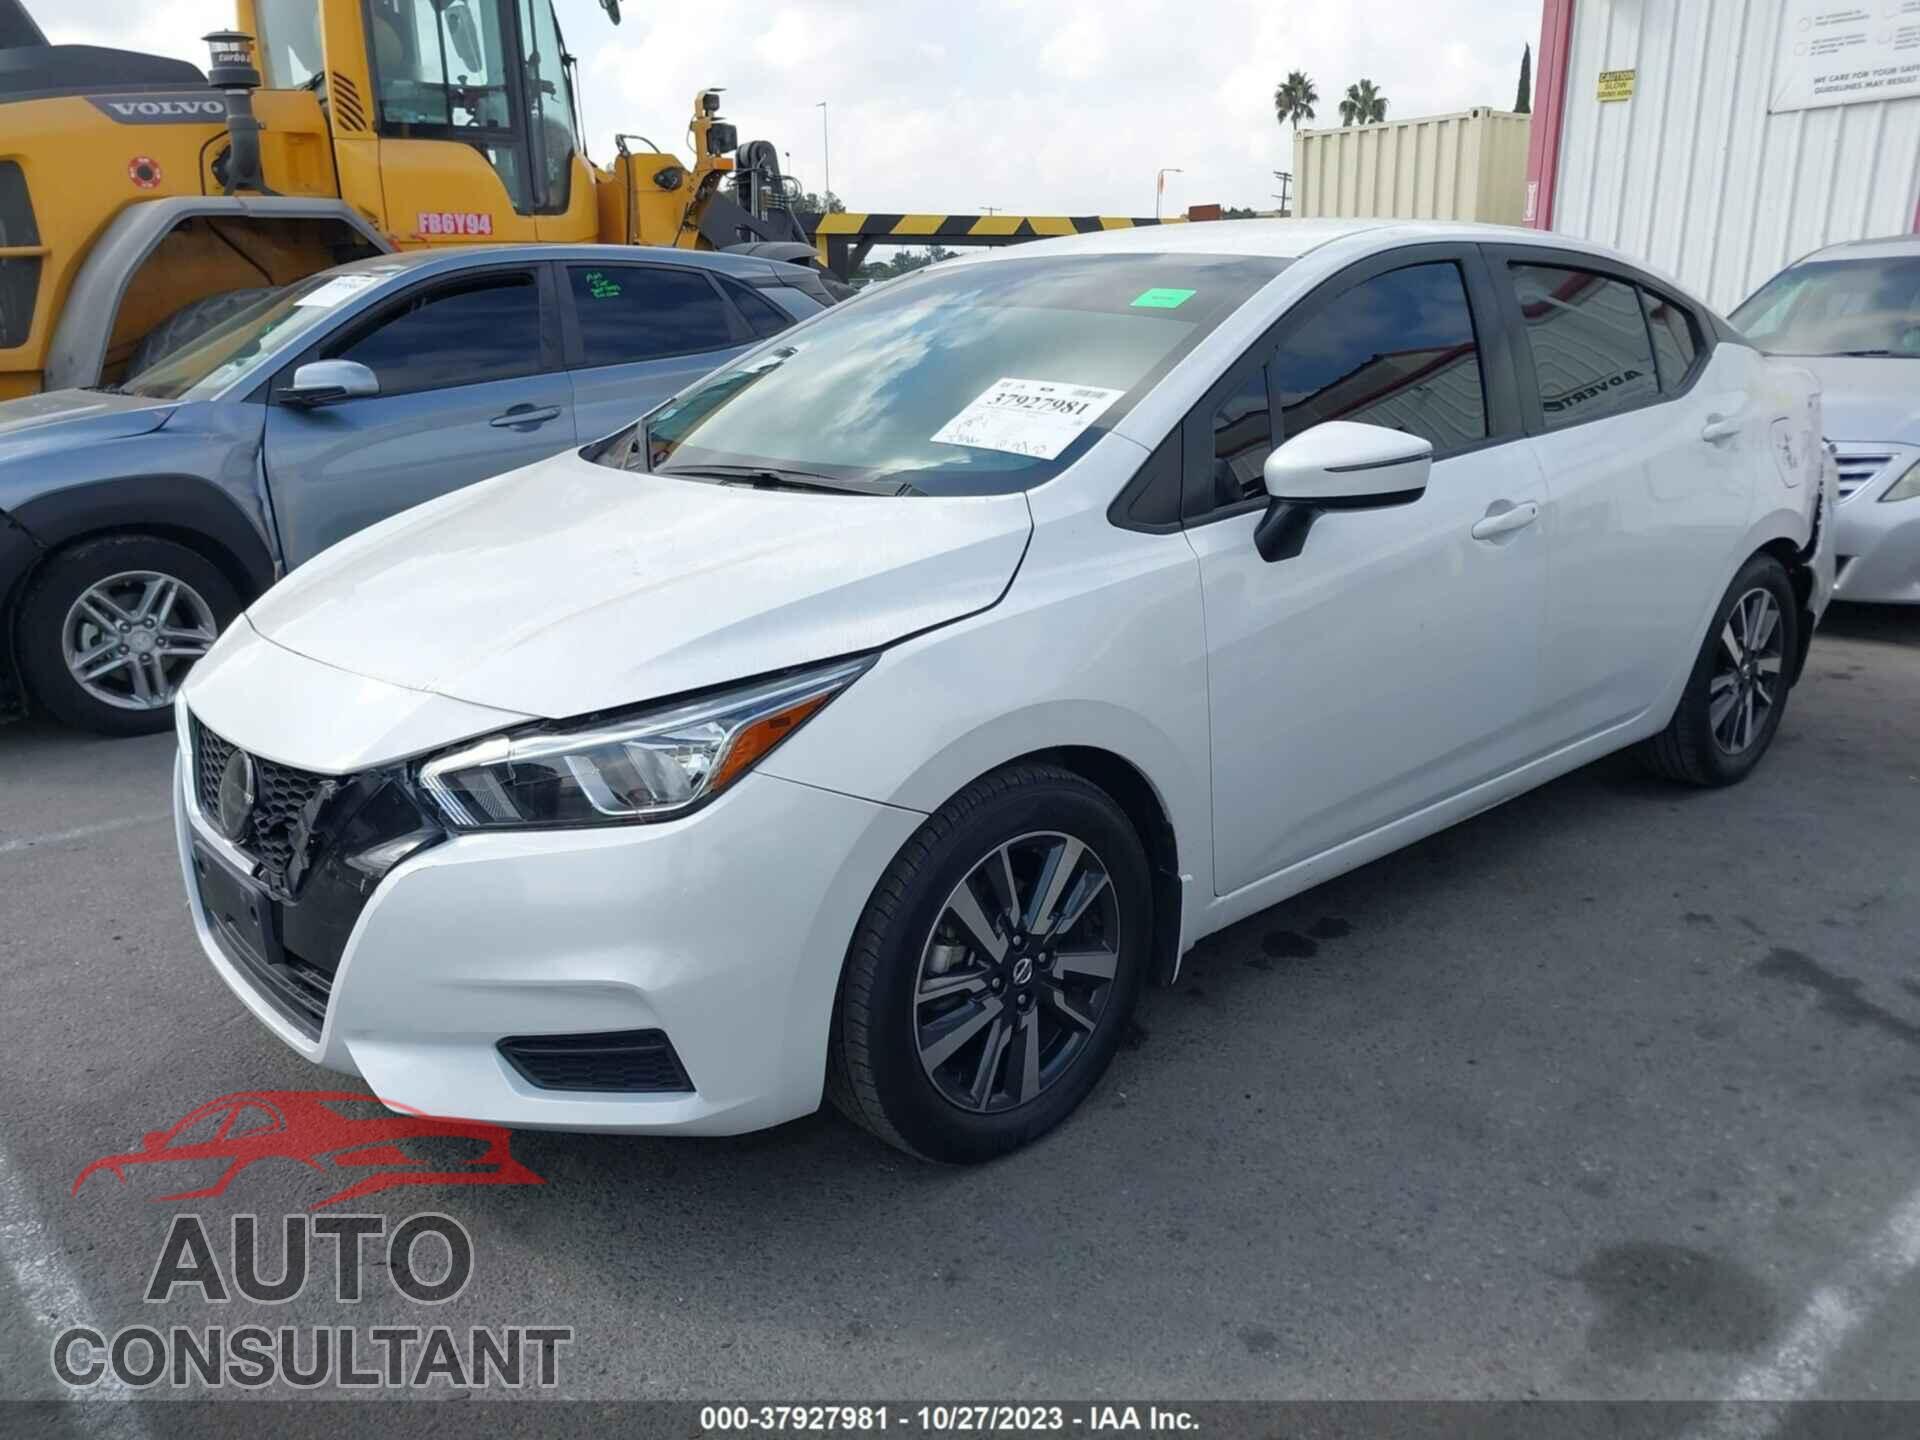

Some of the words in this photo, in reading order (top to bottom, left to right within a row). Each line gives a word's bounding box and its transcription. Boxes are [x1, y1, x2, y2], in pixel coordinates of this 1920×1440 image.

[1828, 73, 1850, 82] CARE
[1852, 71, 1869, 80] FOR
[1872, 67, 1897, 77] YOUR
[1814, 83, 1863, 95] GUIDELINES
[1865, 79, 1884, 88] MAY
[1887, 74, 1917, 86] RESULT
[110, 101, 224, 116] VOLVO
[986, 393, 1090, 415] 37927981
